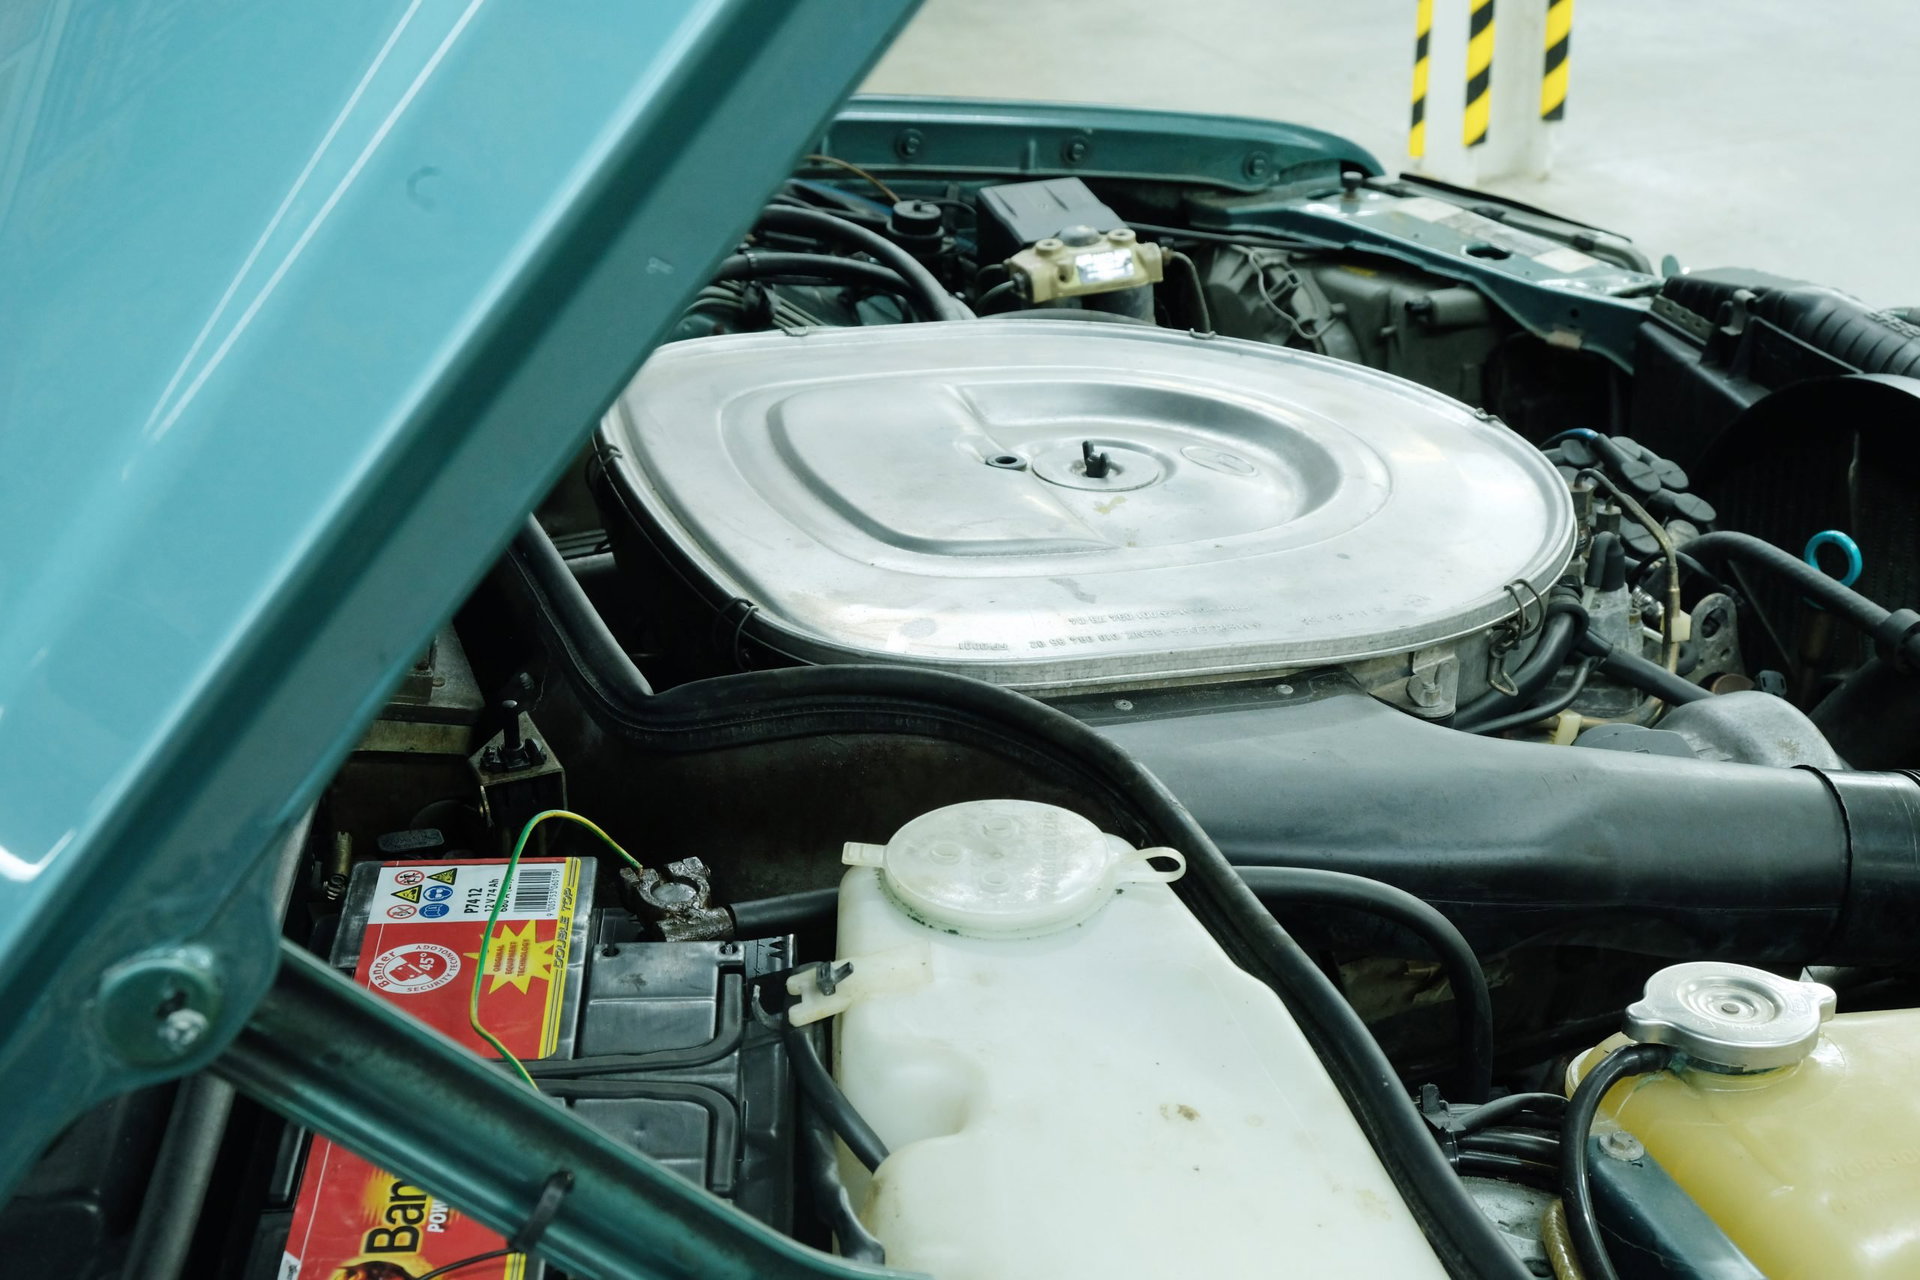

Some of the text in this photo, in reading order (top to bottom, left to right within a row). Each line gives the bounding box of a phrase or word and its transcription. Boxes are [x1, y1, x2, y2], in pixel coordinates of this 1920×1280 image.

[487, 888, 497, 898] 74
[488, 878, 500, 888] Ah
[553, 887, 573, 969] DOUBLE TOP
[373, 951, 396, 988] Banner
[406, 945, 458, 993] SECURITY TECHNOLOGY
[493, 944, 505, 972] ORIGINAL
[505, 941, 517, 975] EQUIPMENT
[517, 938, 531, 977] TECHNOLOGY
